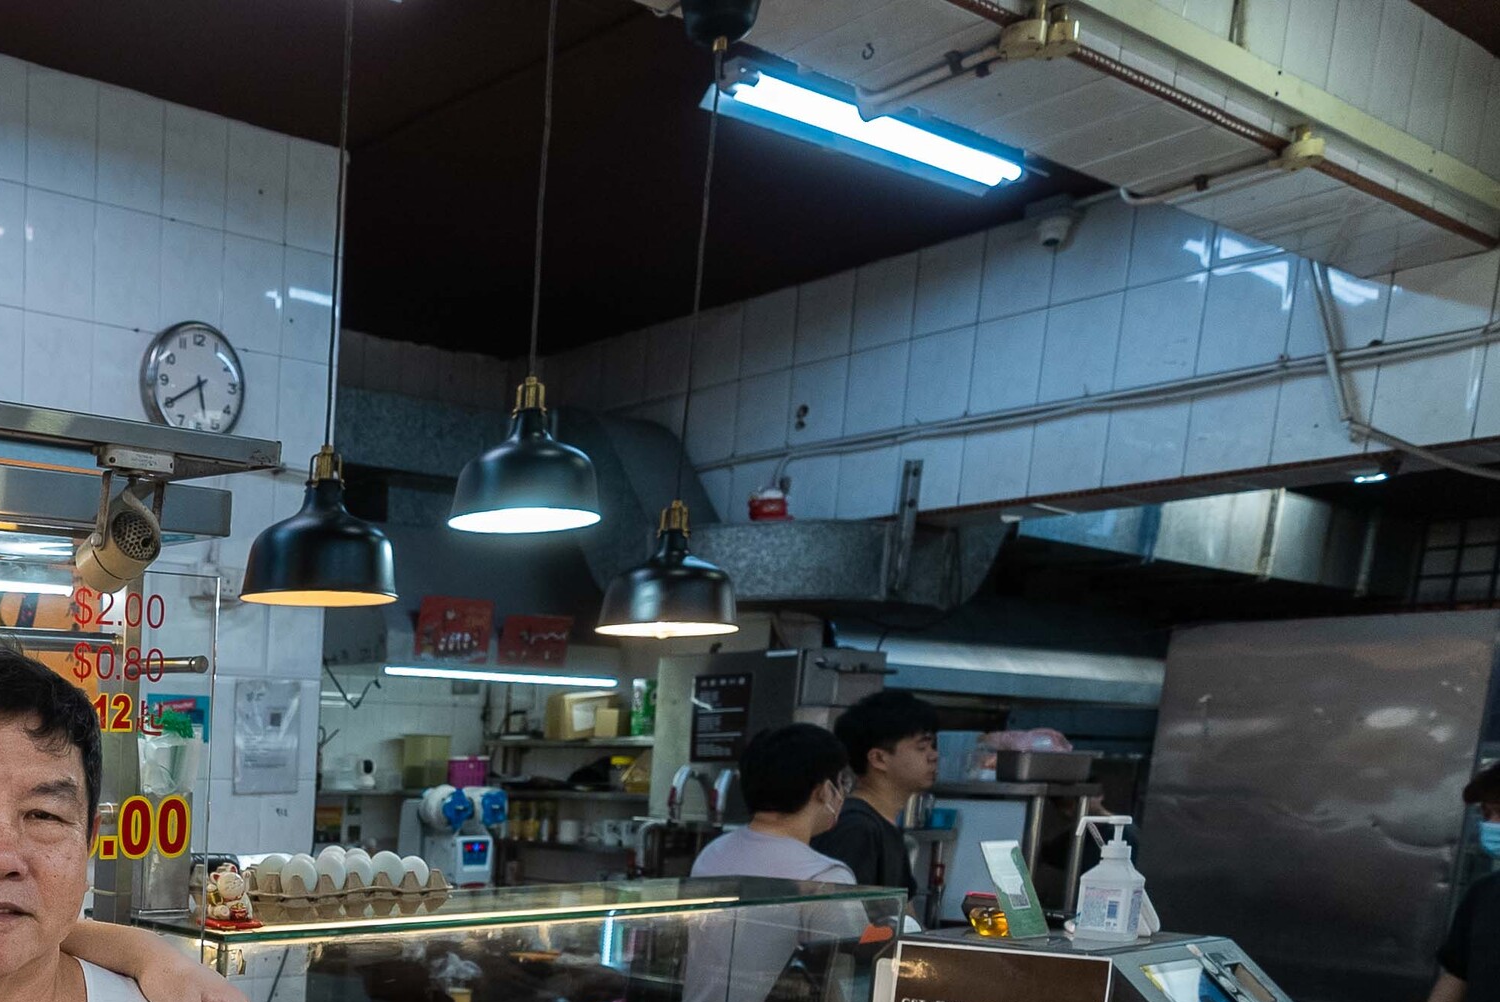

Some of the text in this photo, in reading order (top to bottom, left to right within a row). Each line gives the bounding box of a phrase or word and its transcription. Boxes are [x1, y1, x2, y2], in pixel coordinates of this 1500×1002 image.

[193, 334, 206, 347] 12
[159, 373, 169, 386] 9
[222, 405, 231, 416] 4
[177, 414, 185, 425] 7
[74, 586, 165, 629] $2.00
[73, 641, 164, 683] $0.80
[89, 794, 190, 859] .00
